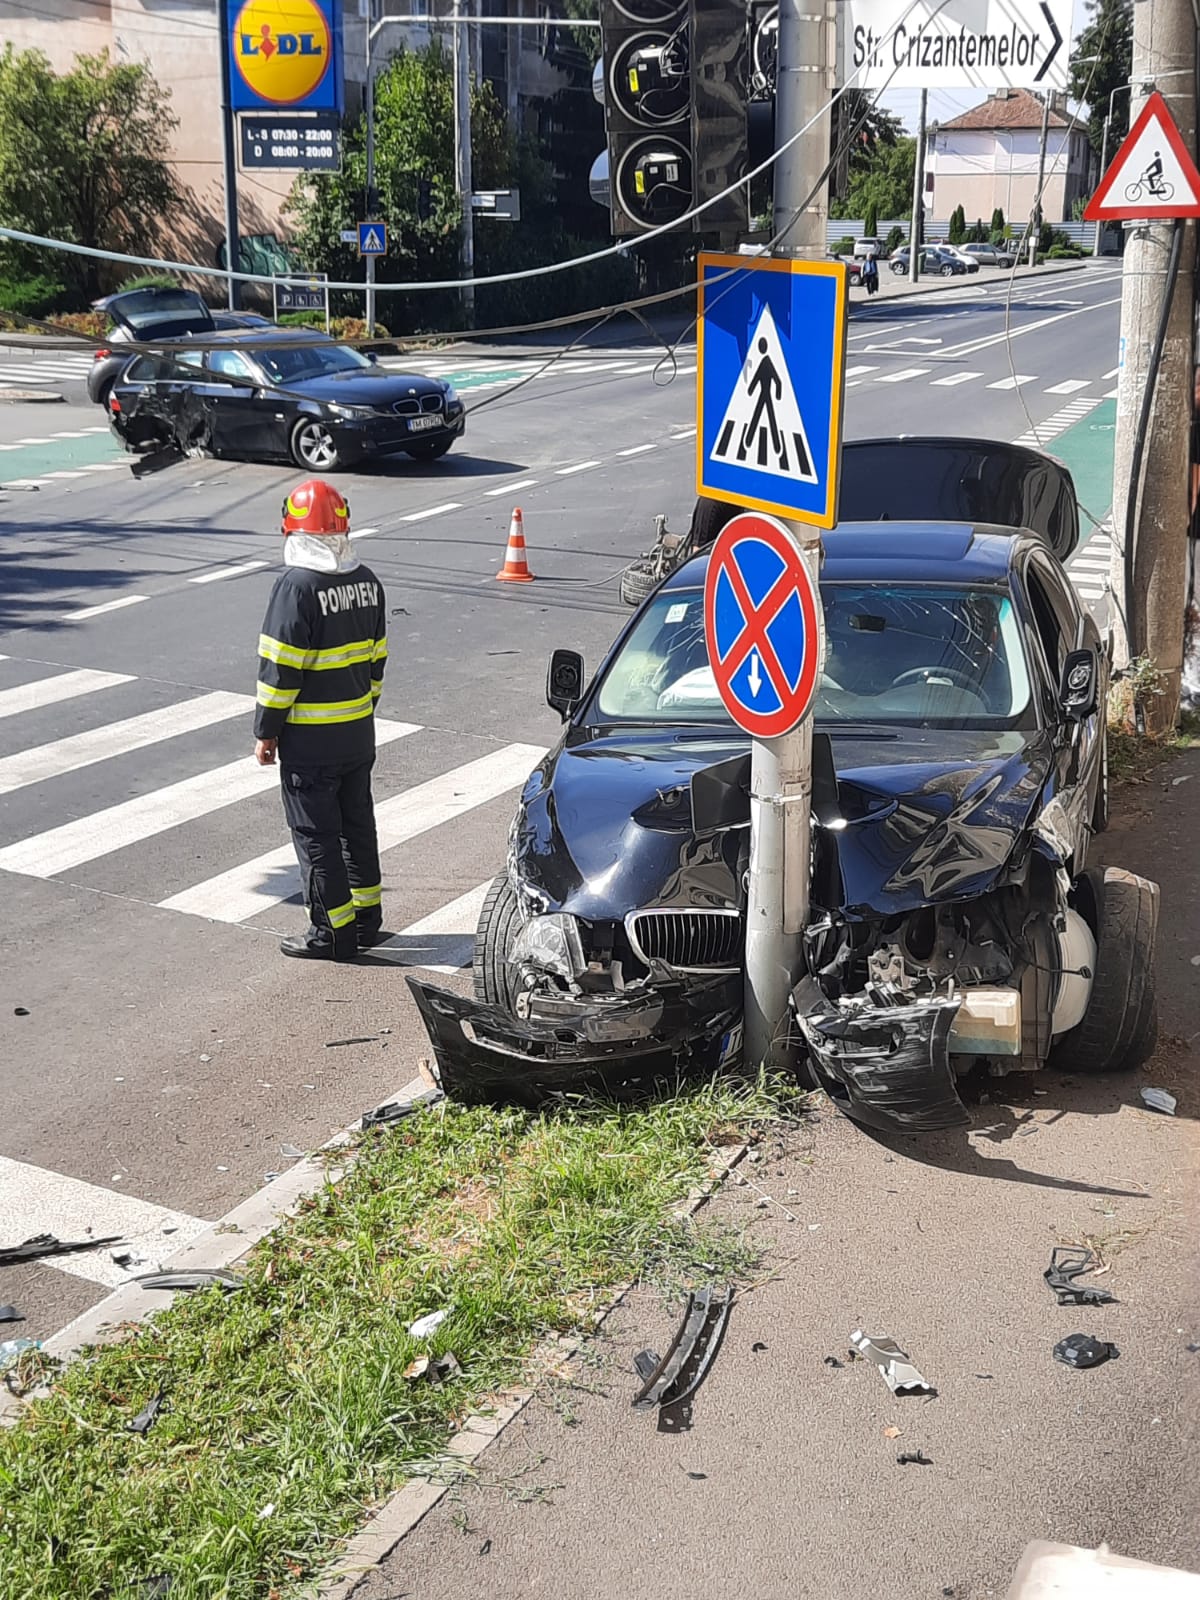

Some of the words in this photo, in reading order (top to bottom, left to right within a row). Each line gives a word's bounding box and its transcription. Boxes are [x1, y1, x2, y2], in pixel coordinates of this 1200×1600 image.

[853, 24, 884, 68] Str.
[892, 22, 1040, 68] Crizantemelor
[247, 129, 254, 140] L
[261, 129, 268, 140] S
[271, 129, 298, 140] 07:30
[305, 129, 332, 140] 22:00
[254, 145, 262, 157] D
[271, 146, 298, 157] 08:00
[305, 146, 333, 157] 20:00
[283, 294, 290, 305] P
